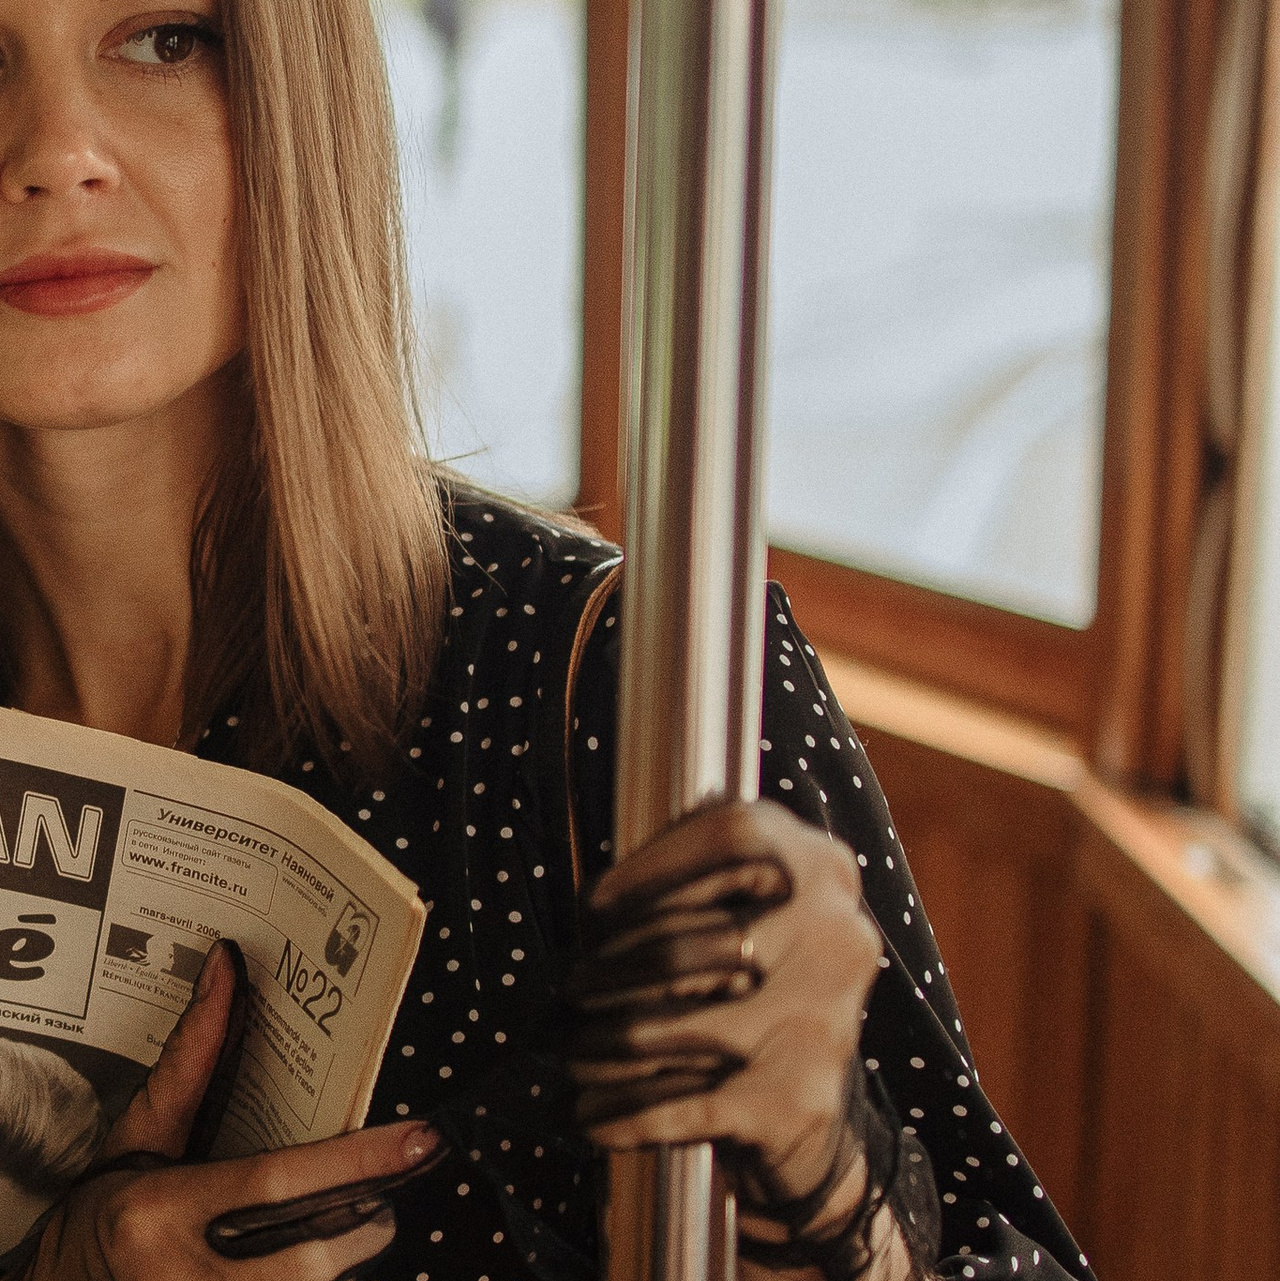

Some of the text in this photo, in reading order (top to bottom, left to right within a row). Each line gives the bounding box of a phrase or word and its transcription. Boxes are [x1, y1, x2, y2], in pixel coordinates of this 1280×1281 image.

[132, 827, 252, 869] русскоязычный сайт газеты
[138, 841, 158, 852] сети
[162, 846, 207, 866] Интернет:
[157, 807, 280, 859] Университет
[281, 851, 336, 905] Наяновой
[129, 850, 249, 897] www.francite.ru
[139, 905, 221, 940] mars-avril 2006
[274, 938, 344, 1037] №22
[43, 1018, 86, 1035] язык
[298, 1040, 311, 1055] par
[294, 1070, 317, 1097] France
